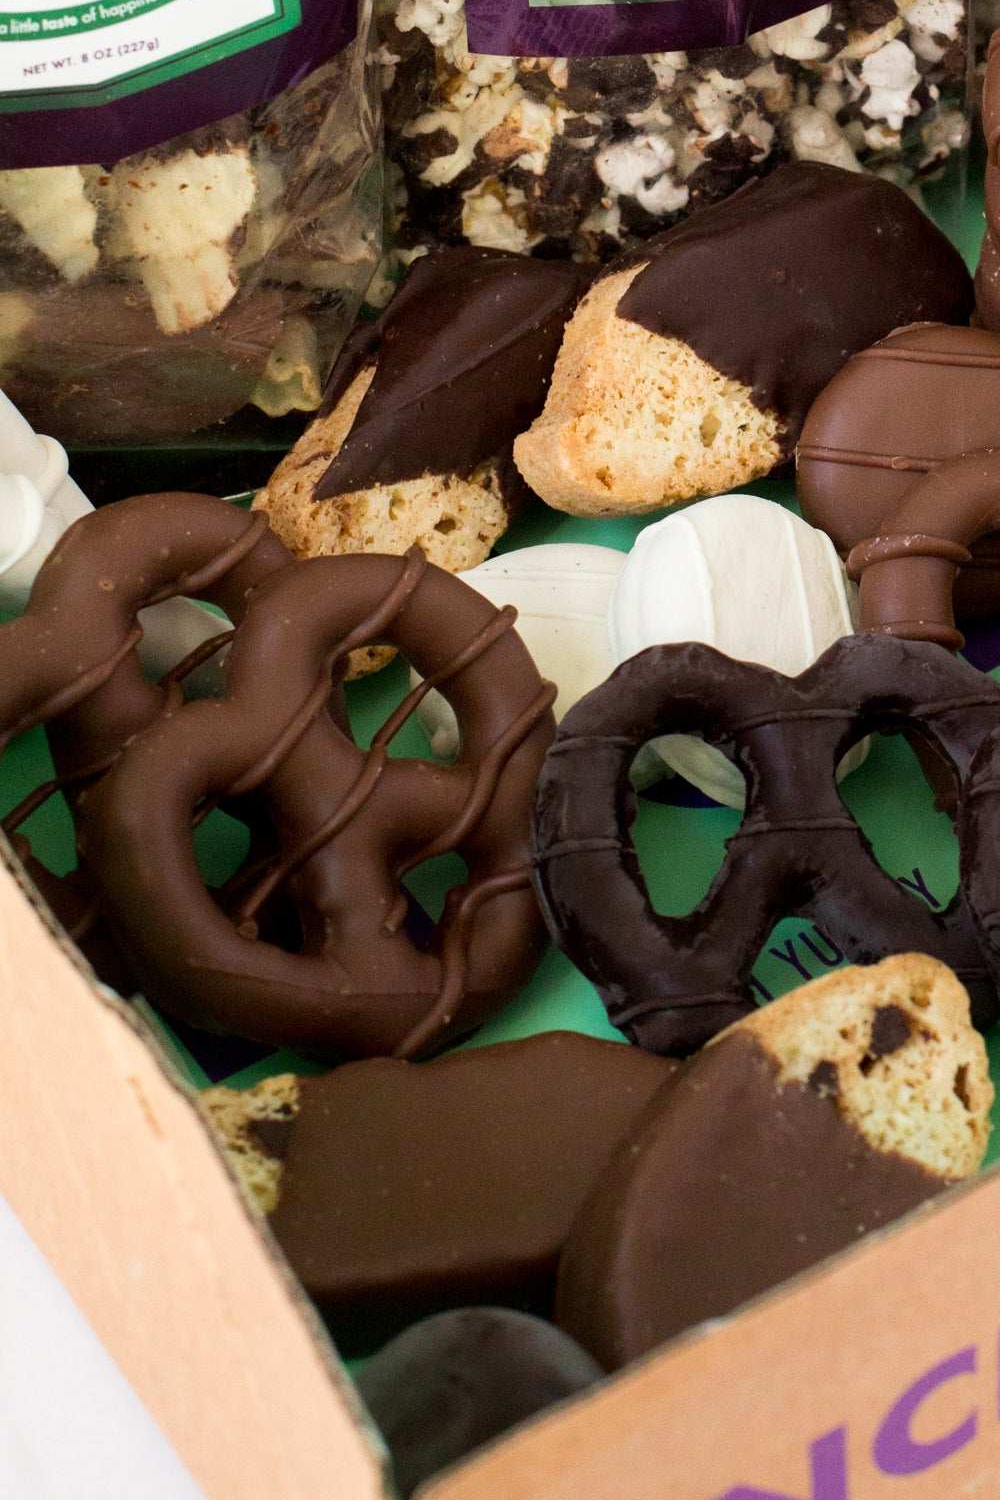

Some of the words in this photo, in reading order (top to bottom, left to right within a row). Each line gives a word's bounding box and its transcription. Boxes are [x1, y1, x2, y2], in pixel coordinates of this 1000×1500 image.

[10, 18, 40, 34] little
[42, 15, 78, 31] taste
[81, 7, 96, 23] of
[23, 63, 47, 76] NET
[82, 53, 89, 63] 8
[94, 48, 114, 60] OZ
[118, 37, 159, 57] (227g)
